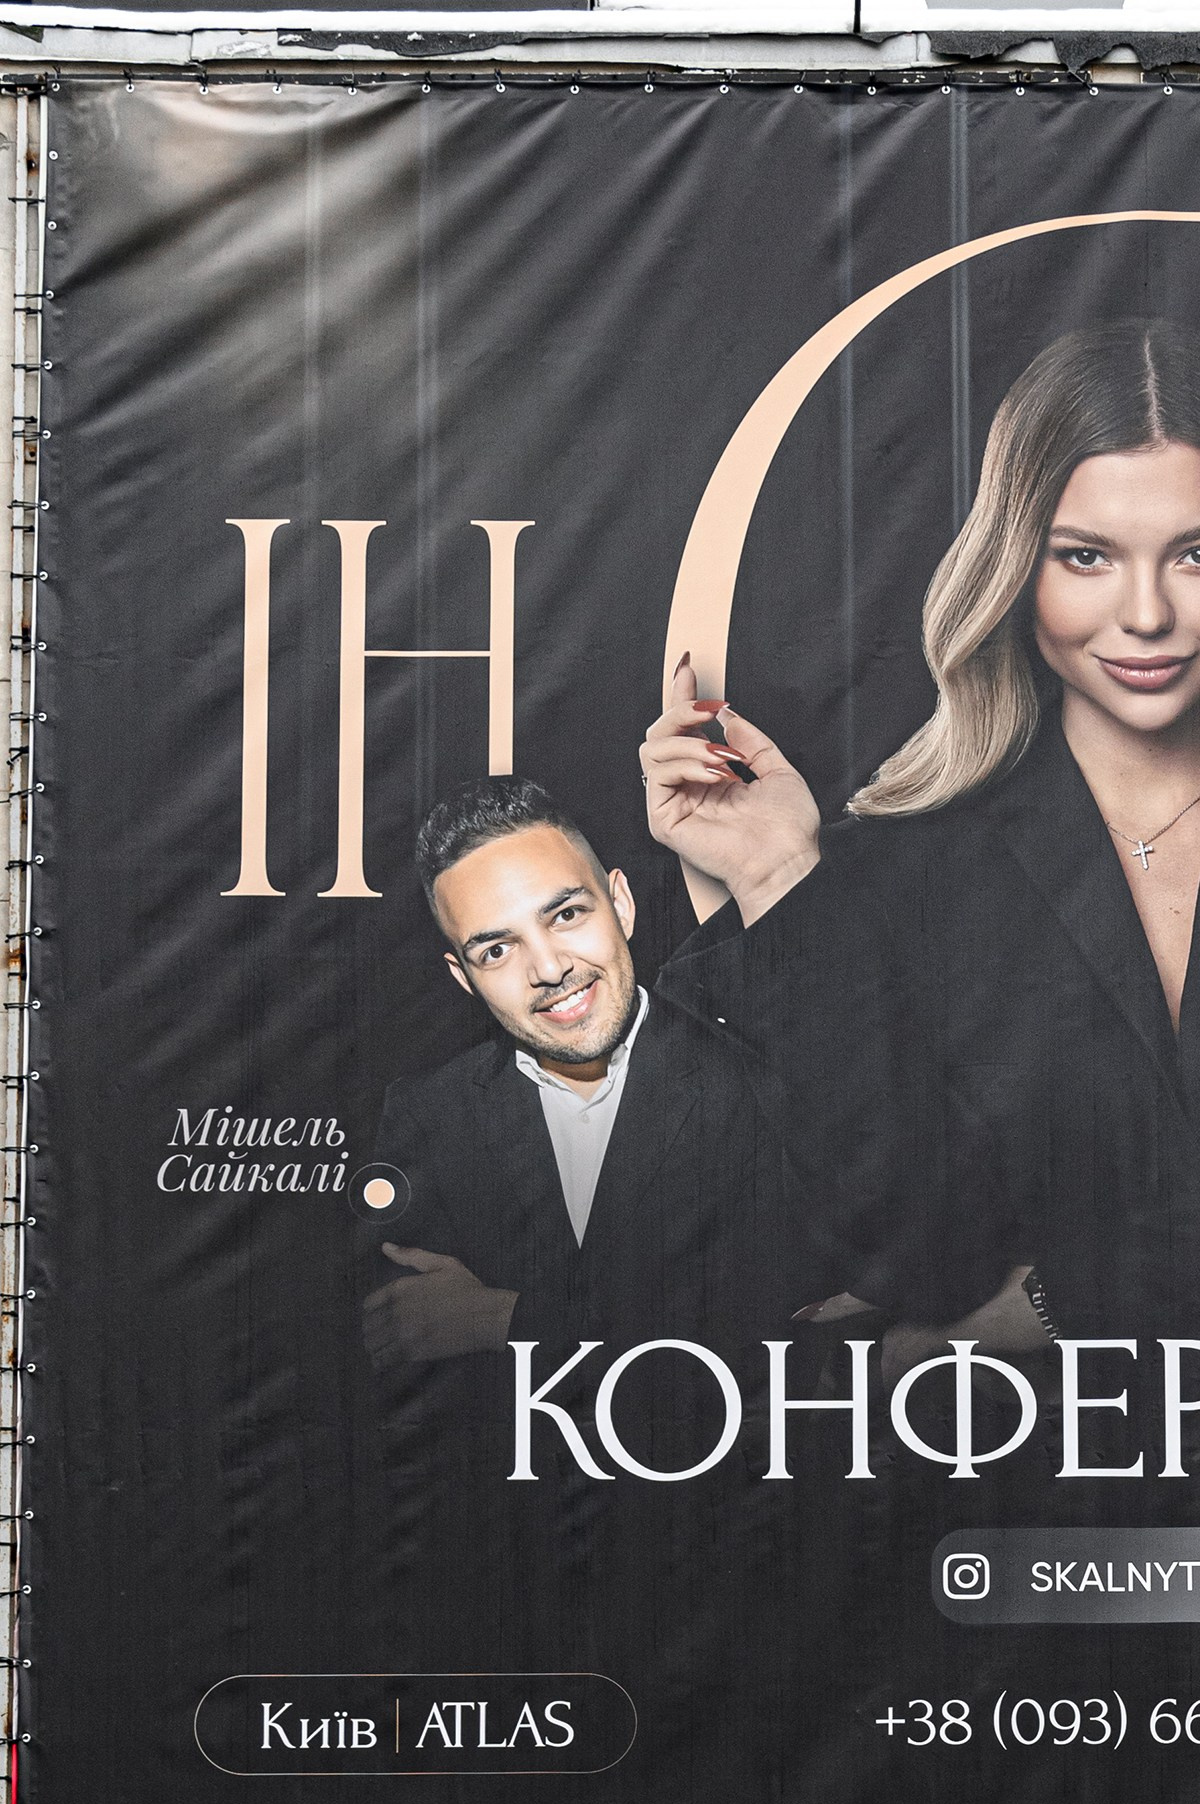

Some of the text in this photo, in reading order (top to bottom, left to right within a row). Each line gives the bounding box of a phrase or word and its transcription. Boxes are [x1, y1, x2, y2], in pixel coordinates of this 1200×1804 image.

[167, 1105, 346, 1147] Мішель
[156, 1151, 349, 1193] Сайкалі
[260, 1702, 378, 1749] Київ
[415, 1700, 575, 1749] ATLAS
[875, 1699, 973, 1746] +38
[993, 1690, 1128, 1751] (093)
